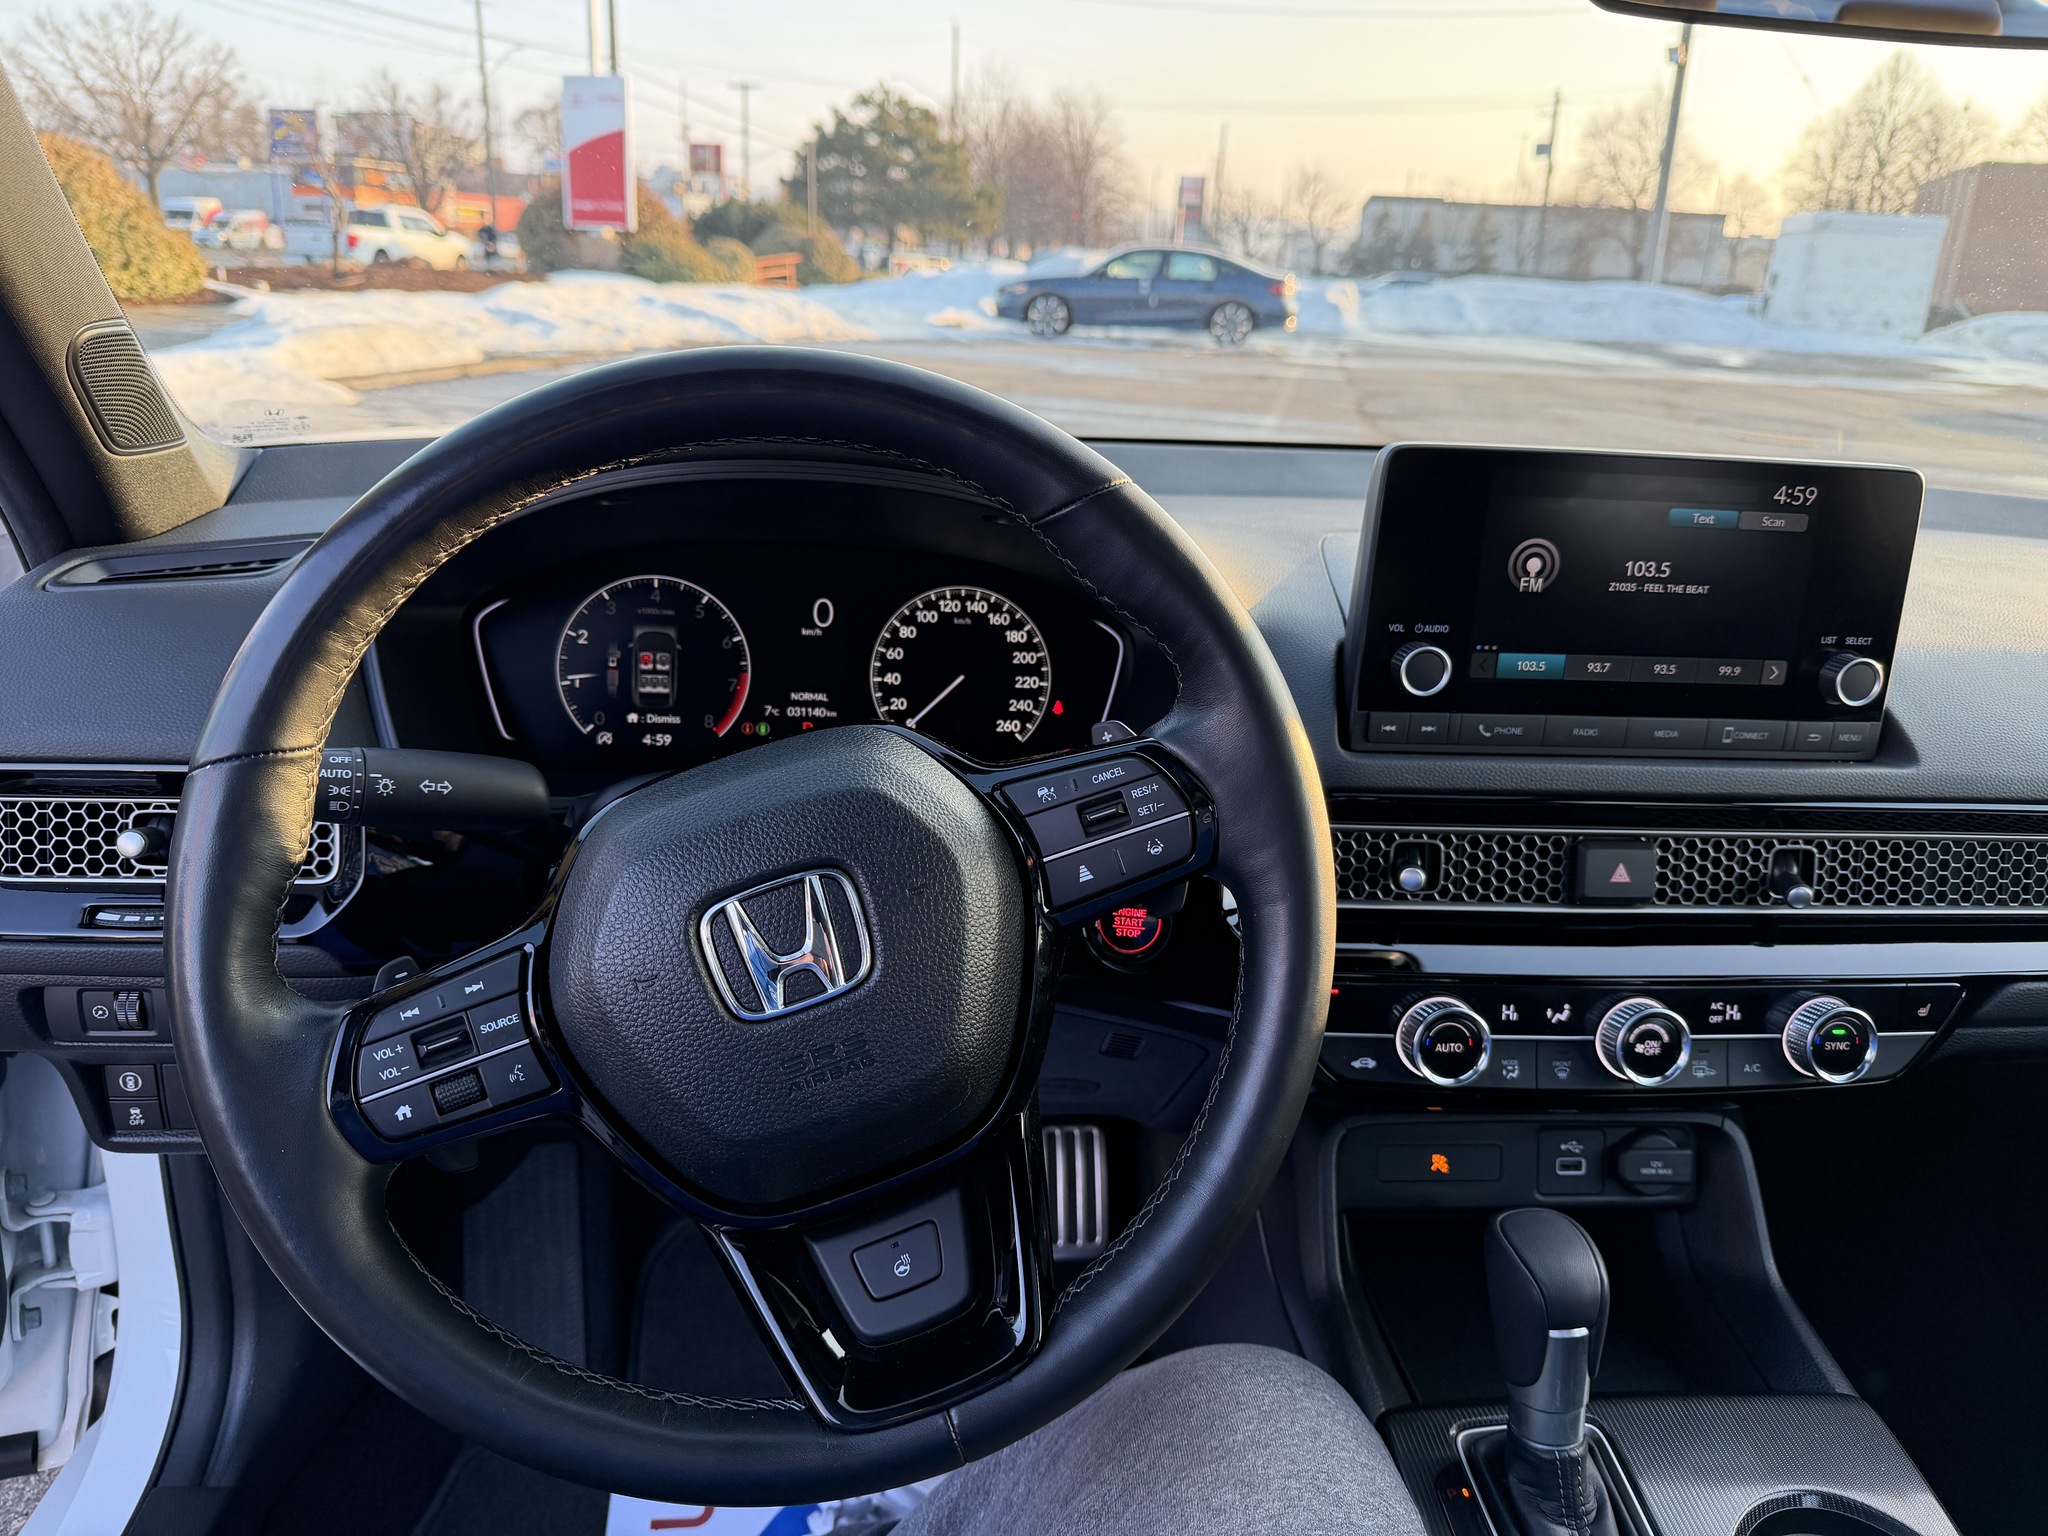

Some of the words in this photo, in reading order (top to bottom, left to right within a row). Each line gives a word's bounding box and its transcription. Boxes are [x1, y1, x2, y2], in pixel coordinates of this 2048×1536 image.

[1773, 485, 1818, 506] 4:59
[1692, 513, 1716, 525] Text
[1761, 516, 1785, 528] Scan
[1624, 560, 1672, 578] 103.5
[1518, 577, 1543, 593] FM
[1608, 582, 1638, 592] Z1035
[1643, 583, 1666, 593] FEEL
[1666, 584, 1685, 594] THE
[1686, 585, 1710, 594] BEAT
[939, 600, 961, 612] 120
[965, 601, 988, 614] 140
[812, 598, 834, 628] 0
[915, 610, 938, 623] 100
[988, 612, 1010, 626] 160
[801, 627, 822, 636] km/h
[899, 626, 916, 639] 80
[1388, 624, 1405, 633] VOL
[1424, 624, 1450, 634] AUDIO
[577, 630, 589, 645] 2
[1005, 630, 1027, 643] 180
[1820, 636, 1838, 645] LIST
[1845, 637, 1873, 646] SELECT
[886, 648, 904, 660] 60
[1012, 652, 1037, 665] 200
[1516, 661, 1546, 672] 103.5
[1587, 662, 1611, 674] 93.7
[1653, 664, 1677, 675] 93.5
[1718, 666, 1742, 677] 99.9
[883, 672, 901, 685] 40
[1015, 676, 1039, 689] 220
[790, 692, 829, 702] NORMAL
[890, 697, 907, 710] 20
[1009, 699, 1033, 712] 240
[646, 713, 682, 724] Dismiss
[996, 719, 1021, 733] 260
[1493, 726, 1524, 736] PHONE
[1572, 728, 1599, 737] RADIO
[1654, 730, 1679, 739] MEDIA
[1733, 731, 1769, 741] CONNECT
[1838, 734, 1862, 743] MENU
[642, 733, 673, 746] 4:59
[329, 756, 352, 764] OFF
[319, 769, 353, 779] AUTO
[1091, 766, 1126, 785] CANCEL
[1131, 783, 1159, 799] RES/+
[1114, 916, 1144, 927] START
[1116, 928, 1142, 938] STOP
[1710, 1002, 1724, 1011] A/C
[480, 1013, 520, 1034] SOURCE
[1708, 1015, 1723, 1024] OFF
[1434, 1043, 1464, 1053] AUTO
[1644, 1040, 1662, 1048] ON/
[1824, 1041, 1851, 1051] SYNC
[1644, 1047, 1662, 1056] OFF
[1552, 1060, 1572, 1068] FRONT
[1743, 1063, 1761, 1073] A/C
